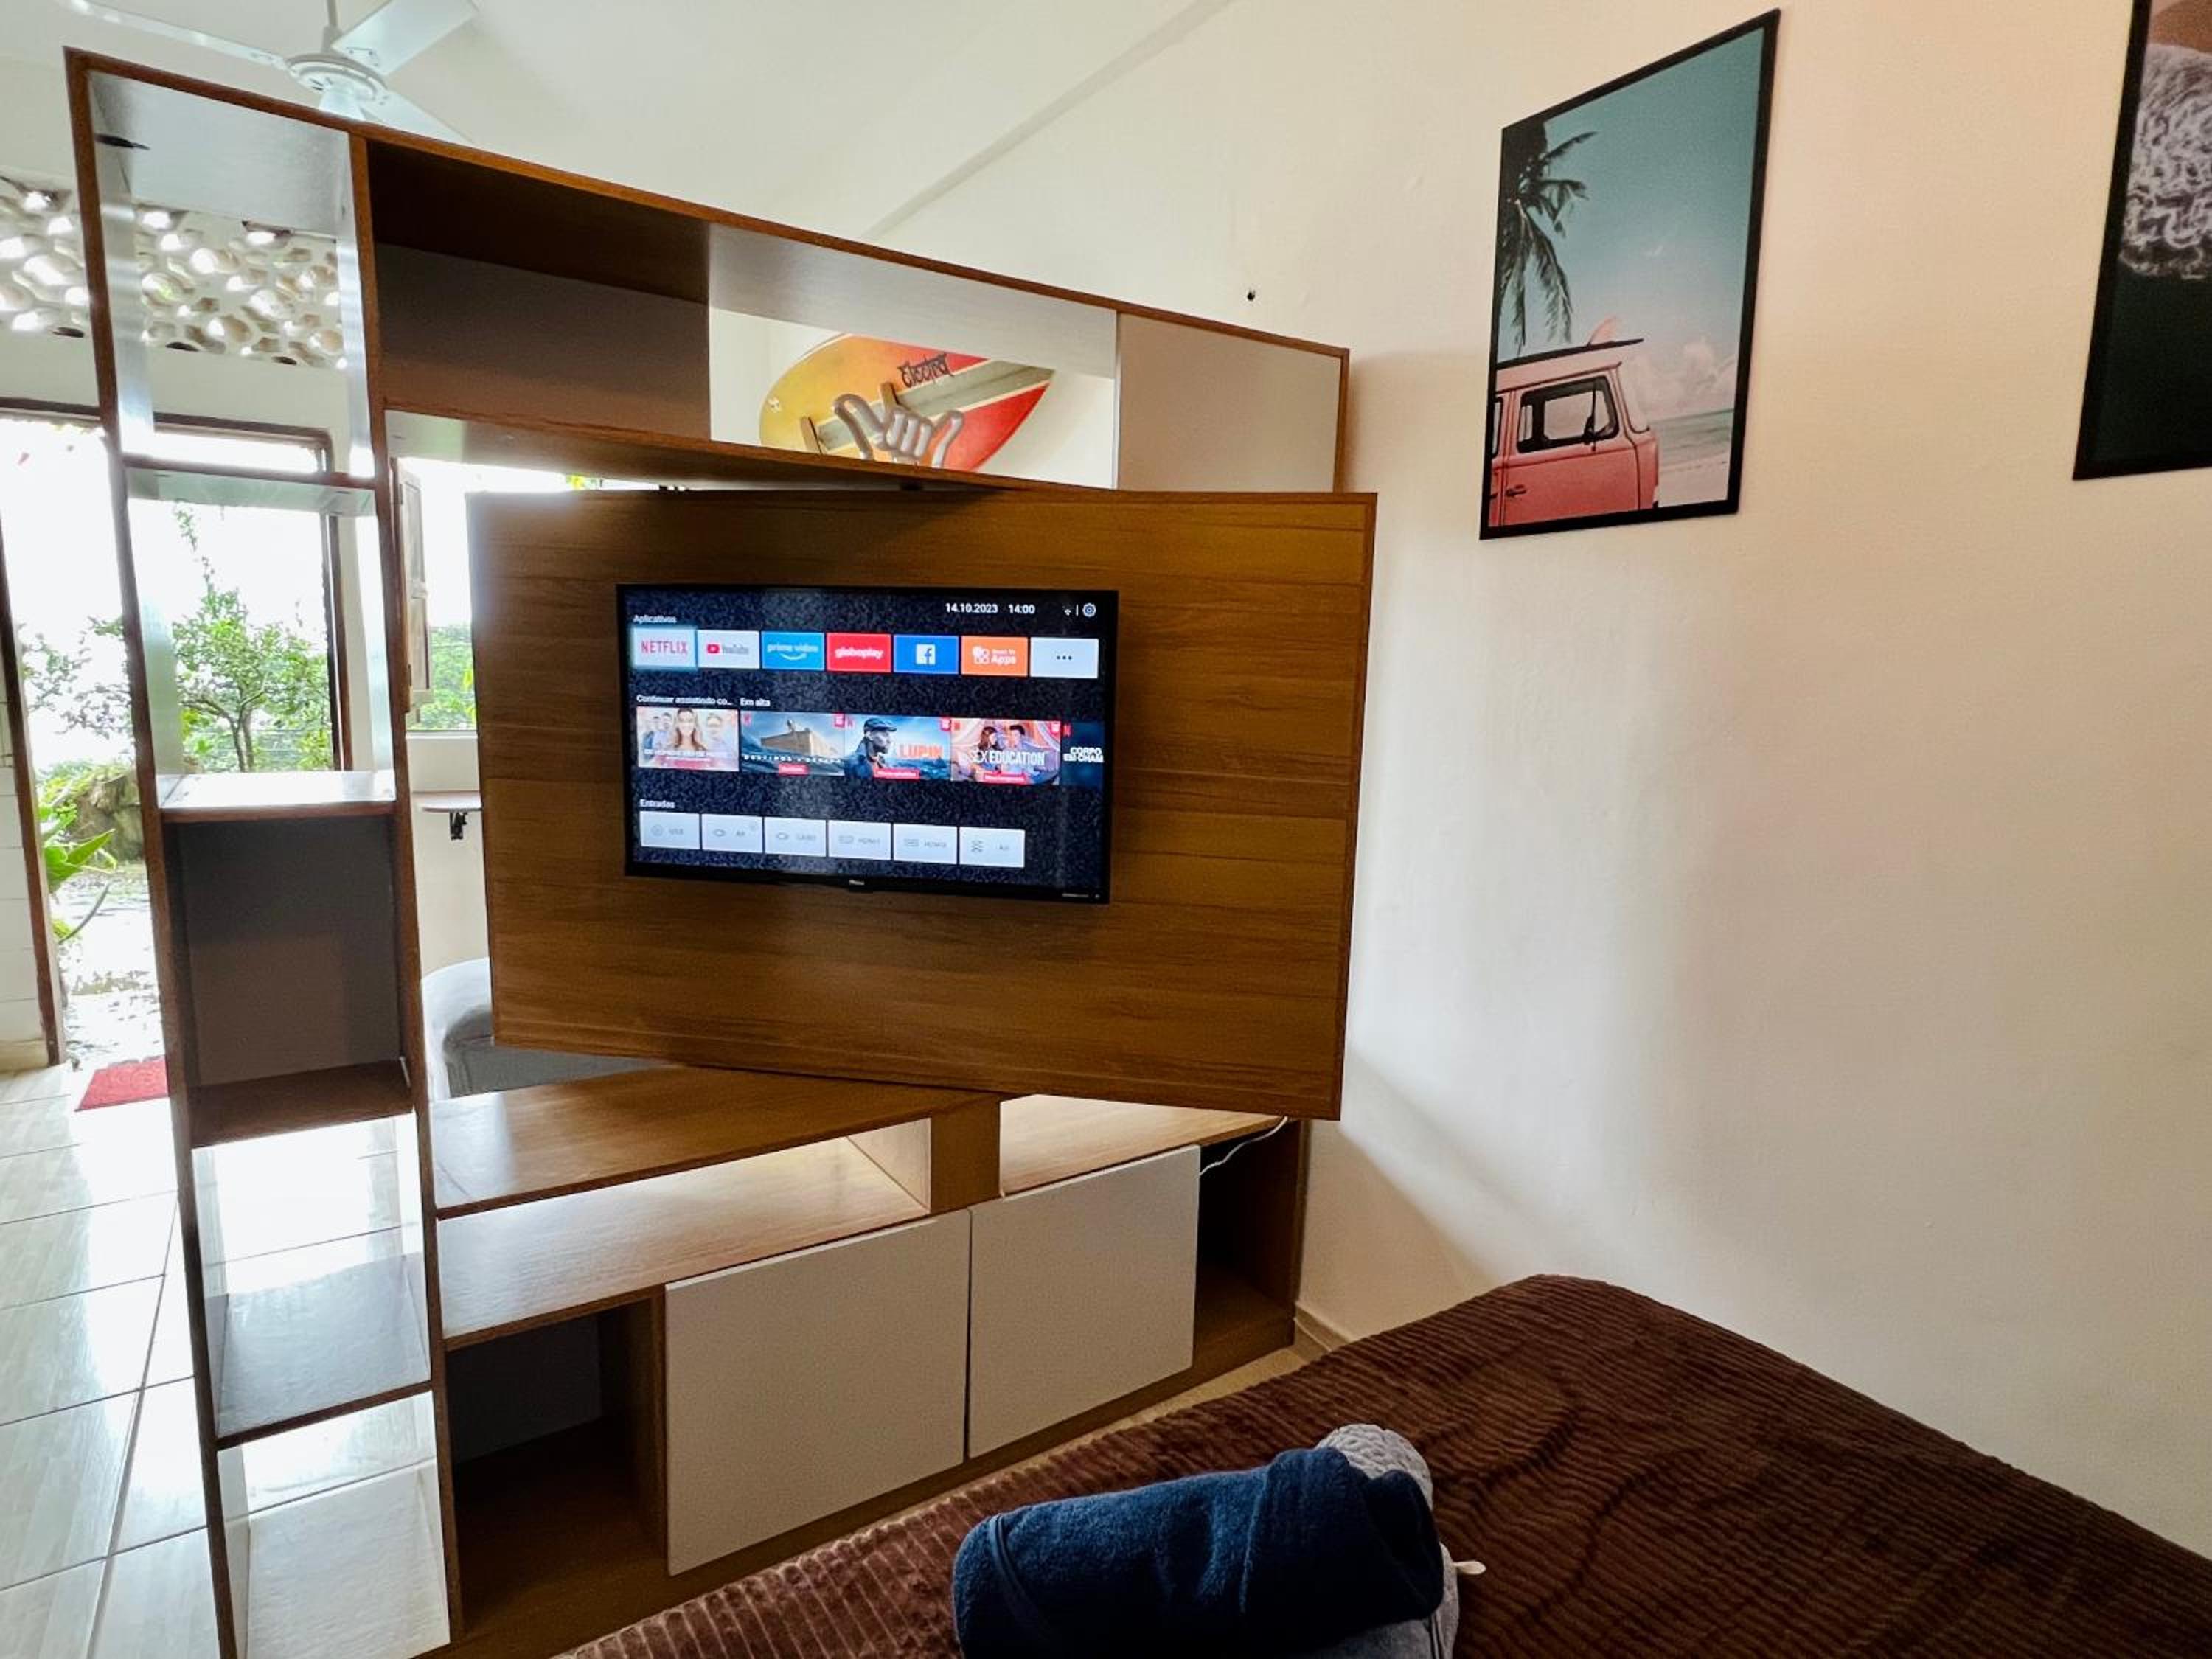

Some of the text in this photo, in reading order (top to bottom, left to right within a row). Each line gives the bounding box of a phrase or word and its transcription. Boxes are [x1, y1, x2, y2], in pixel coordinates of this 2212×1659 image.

[945, 602, 1035, 614] 14.10.2023 14:00
[633, 615, 677, 625] Aplicativos
[641, 640, 687, 654] NETFLIX
[835, 647, 884, 661] globoplay
[991, 655, 1016, 665] Apps
[740, 697, 771, 707] Em alta
[897, 743, 942, 759] LUPIN
[1070, 747, 1102, 755] CORPO
[988, 749, 1045, 766] EDUCATION
[639, 799, 675, 809] Entradas
